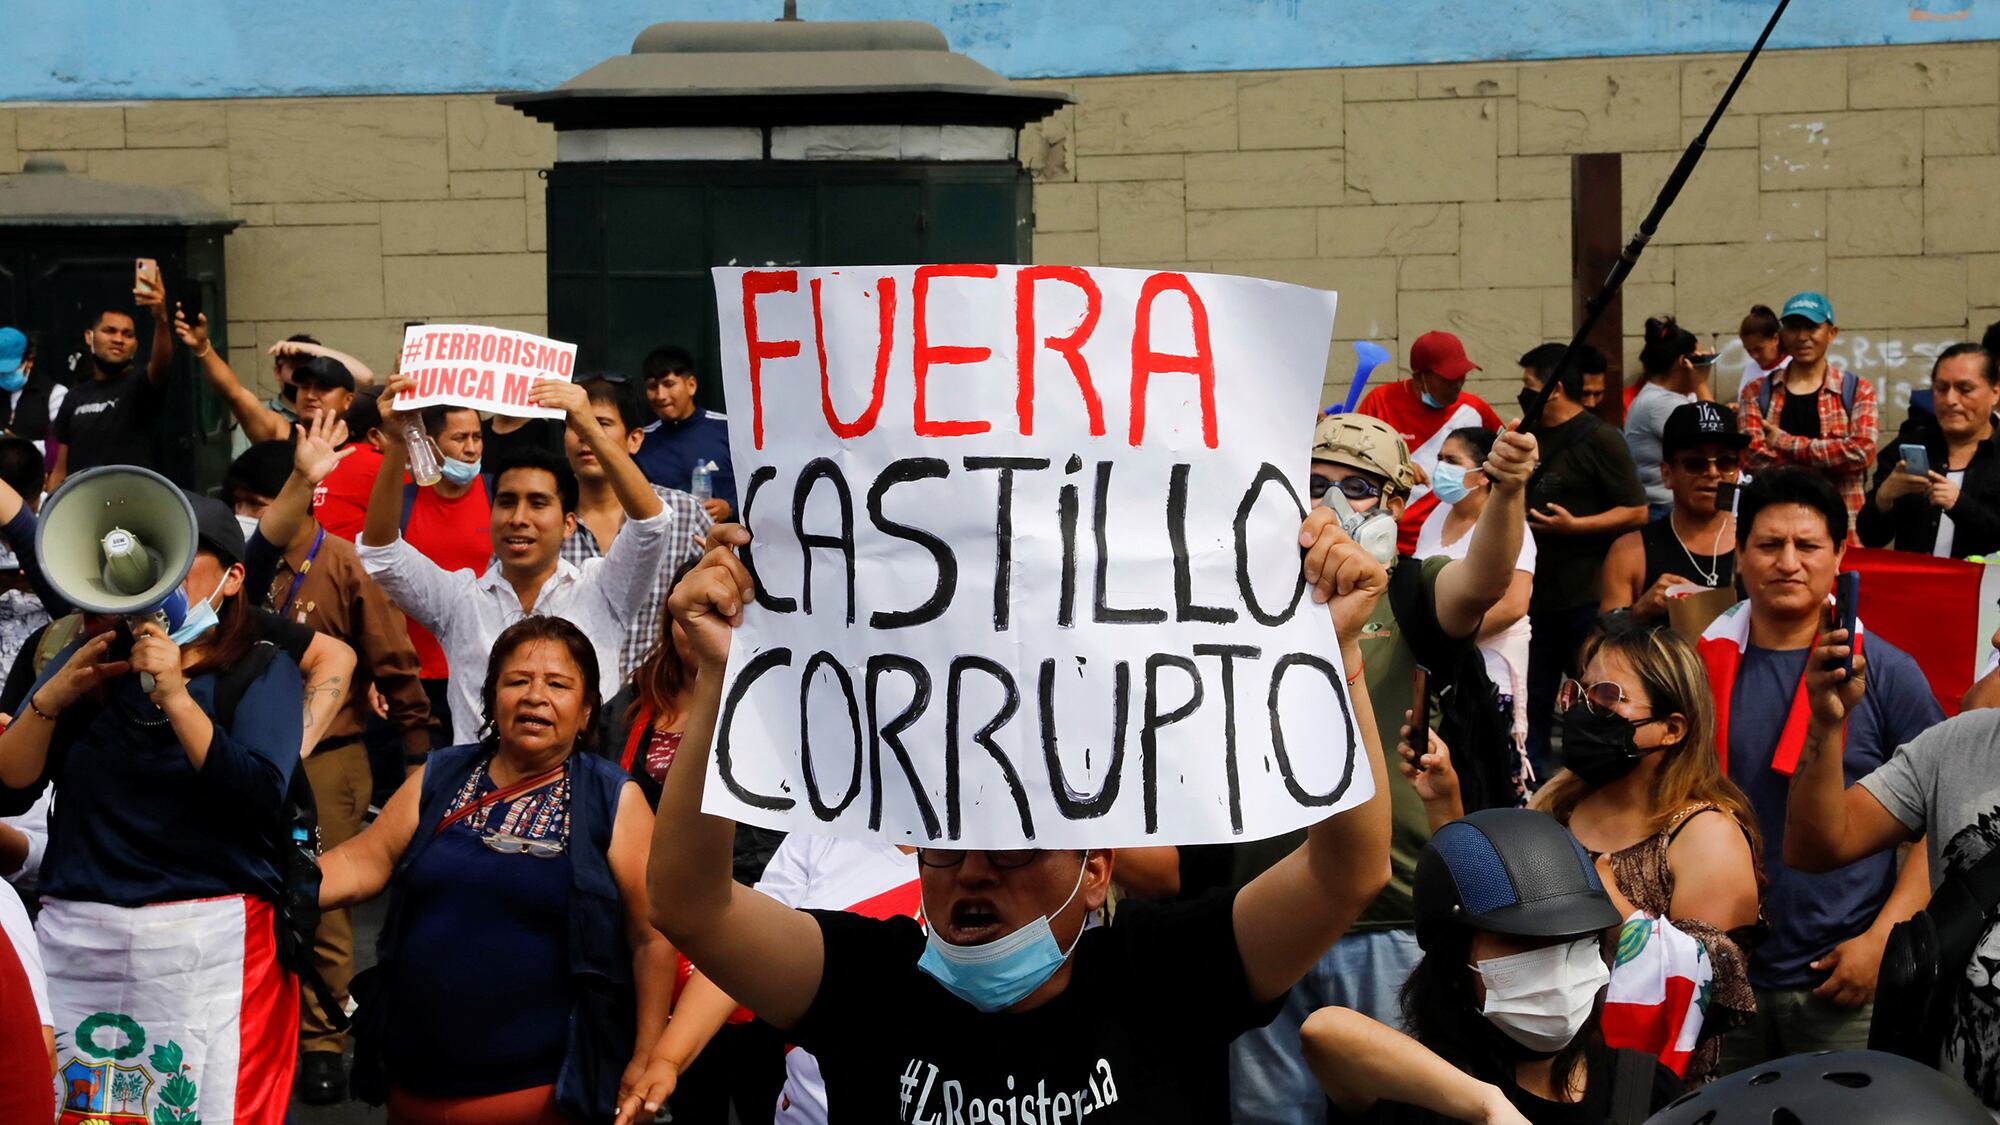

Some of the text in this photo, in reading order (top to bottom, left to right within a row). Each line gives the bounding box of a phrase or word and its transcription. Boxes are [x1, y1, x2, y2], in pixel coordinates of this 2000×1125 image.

[399, 368, 495, 400] NUNCA
[404, 333, 573, 377] #TERRORISMO
[742, 264, 1219, 450] FUERA
[715, 644, 1356, 841] CORRUPTO
